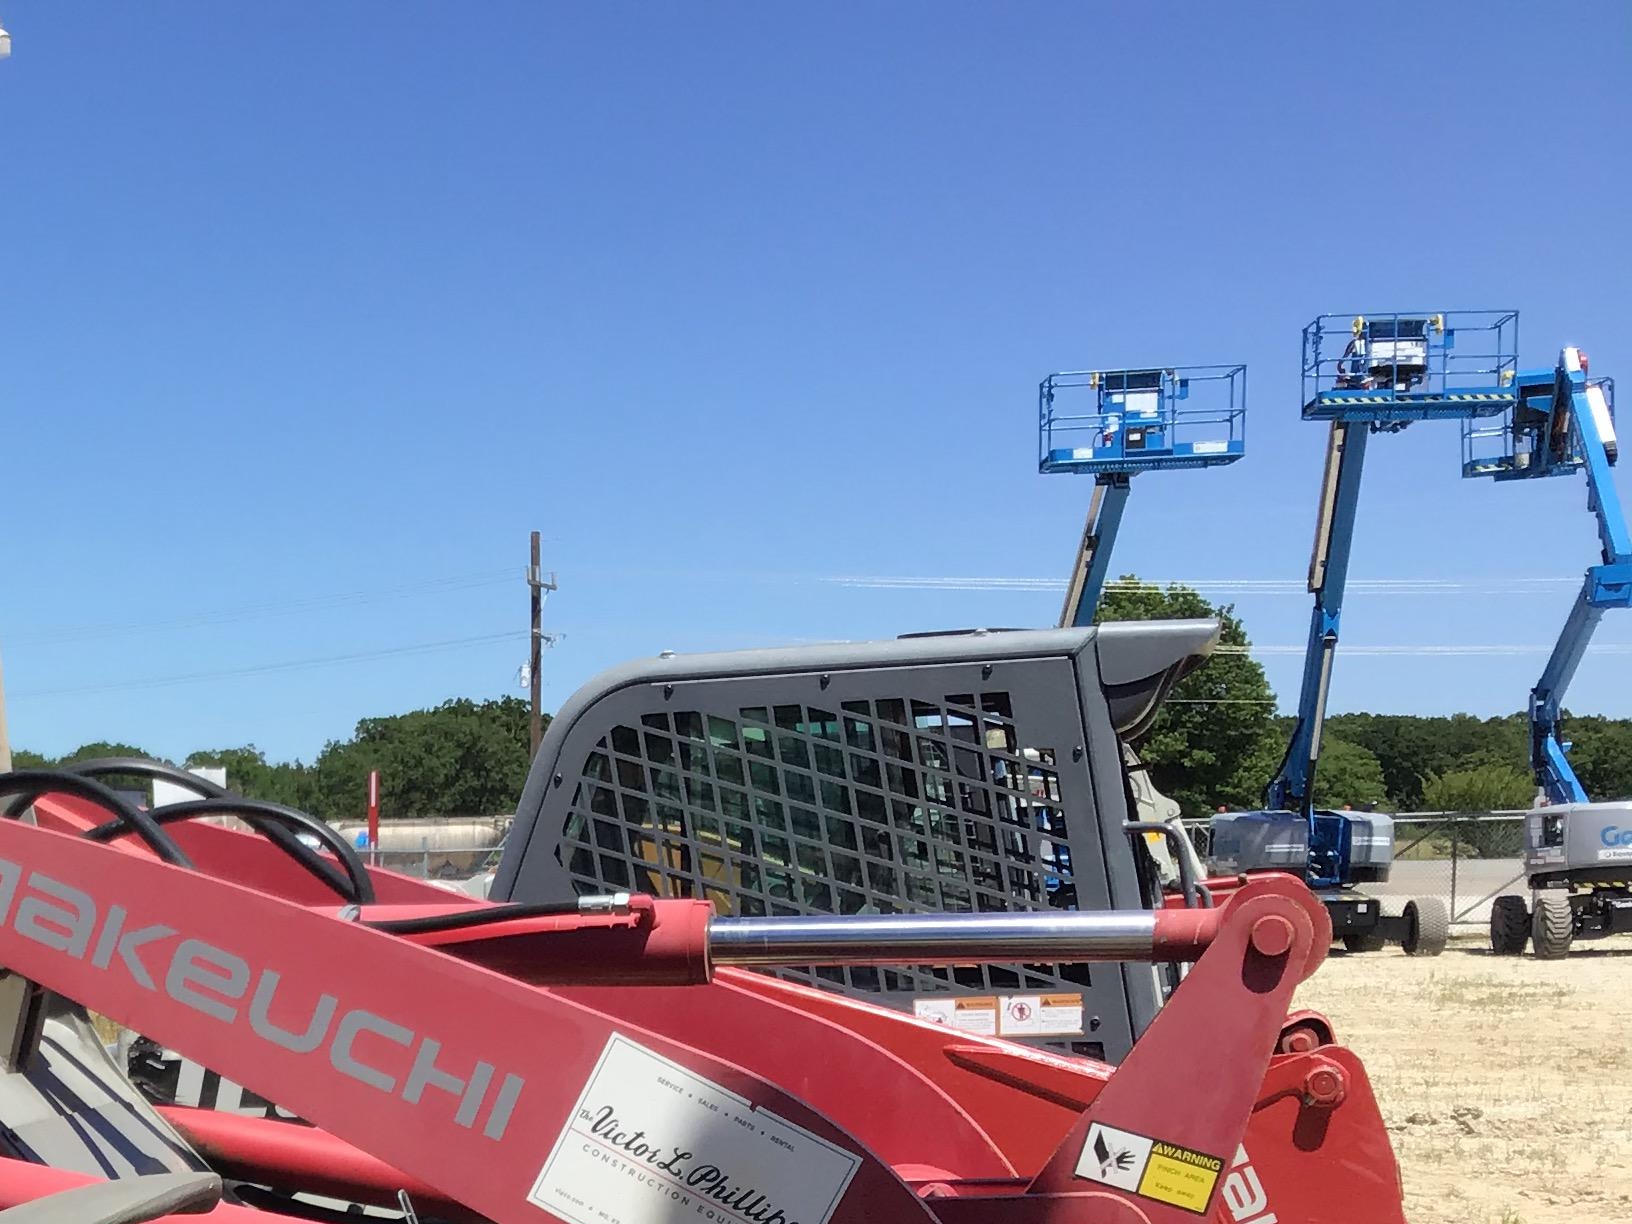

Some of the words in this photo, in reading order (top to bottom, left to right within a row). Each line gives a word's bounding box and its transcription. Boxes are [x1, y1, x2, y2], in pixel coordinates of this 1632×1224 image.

[591, 1105, 662, 1163] Victor
[656, 1147, 693, 1180] L.
[657, 1076, 684, 1094] SERVICE
[698, 1098, 719, 1113] SALES
[733, 1115, 756, 1132] PARTS
[770, 1135, 796, 1152] RENTAL
[583, 1143, 690, 1206] CONSTRUCTION
[1163, 1145, 1221, 1171] WARNING
